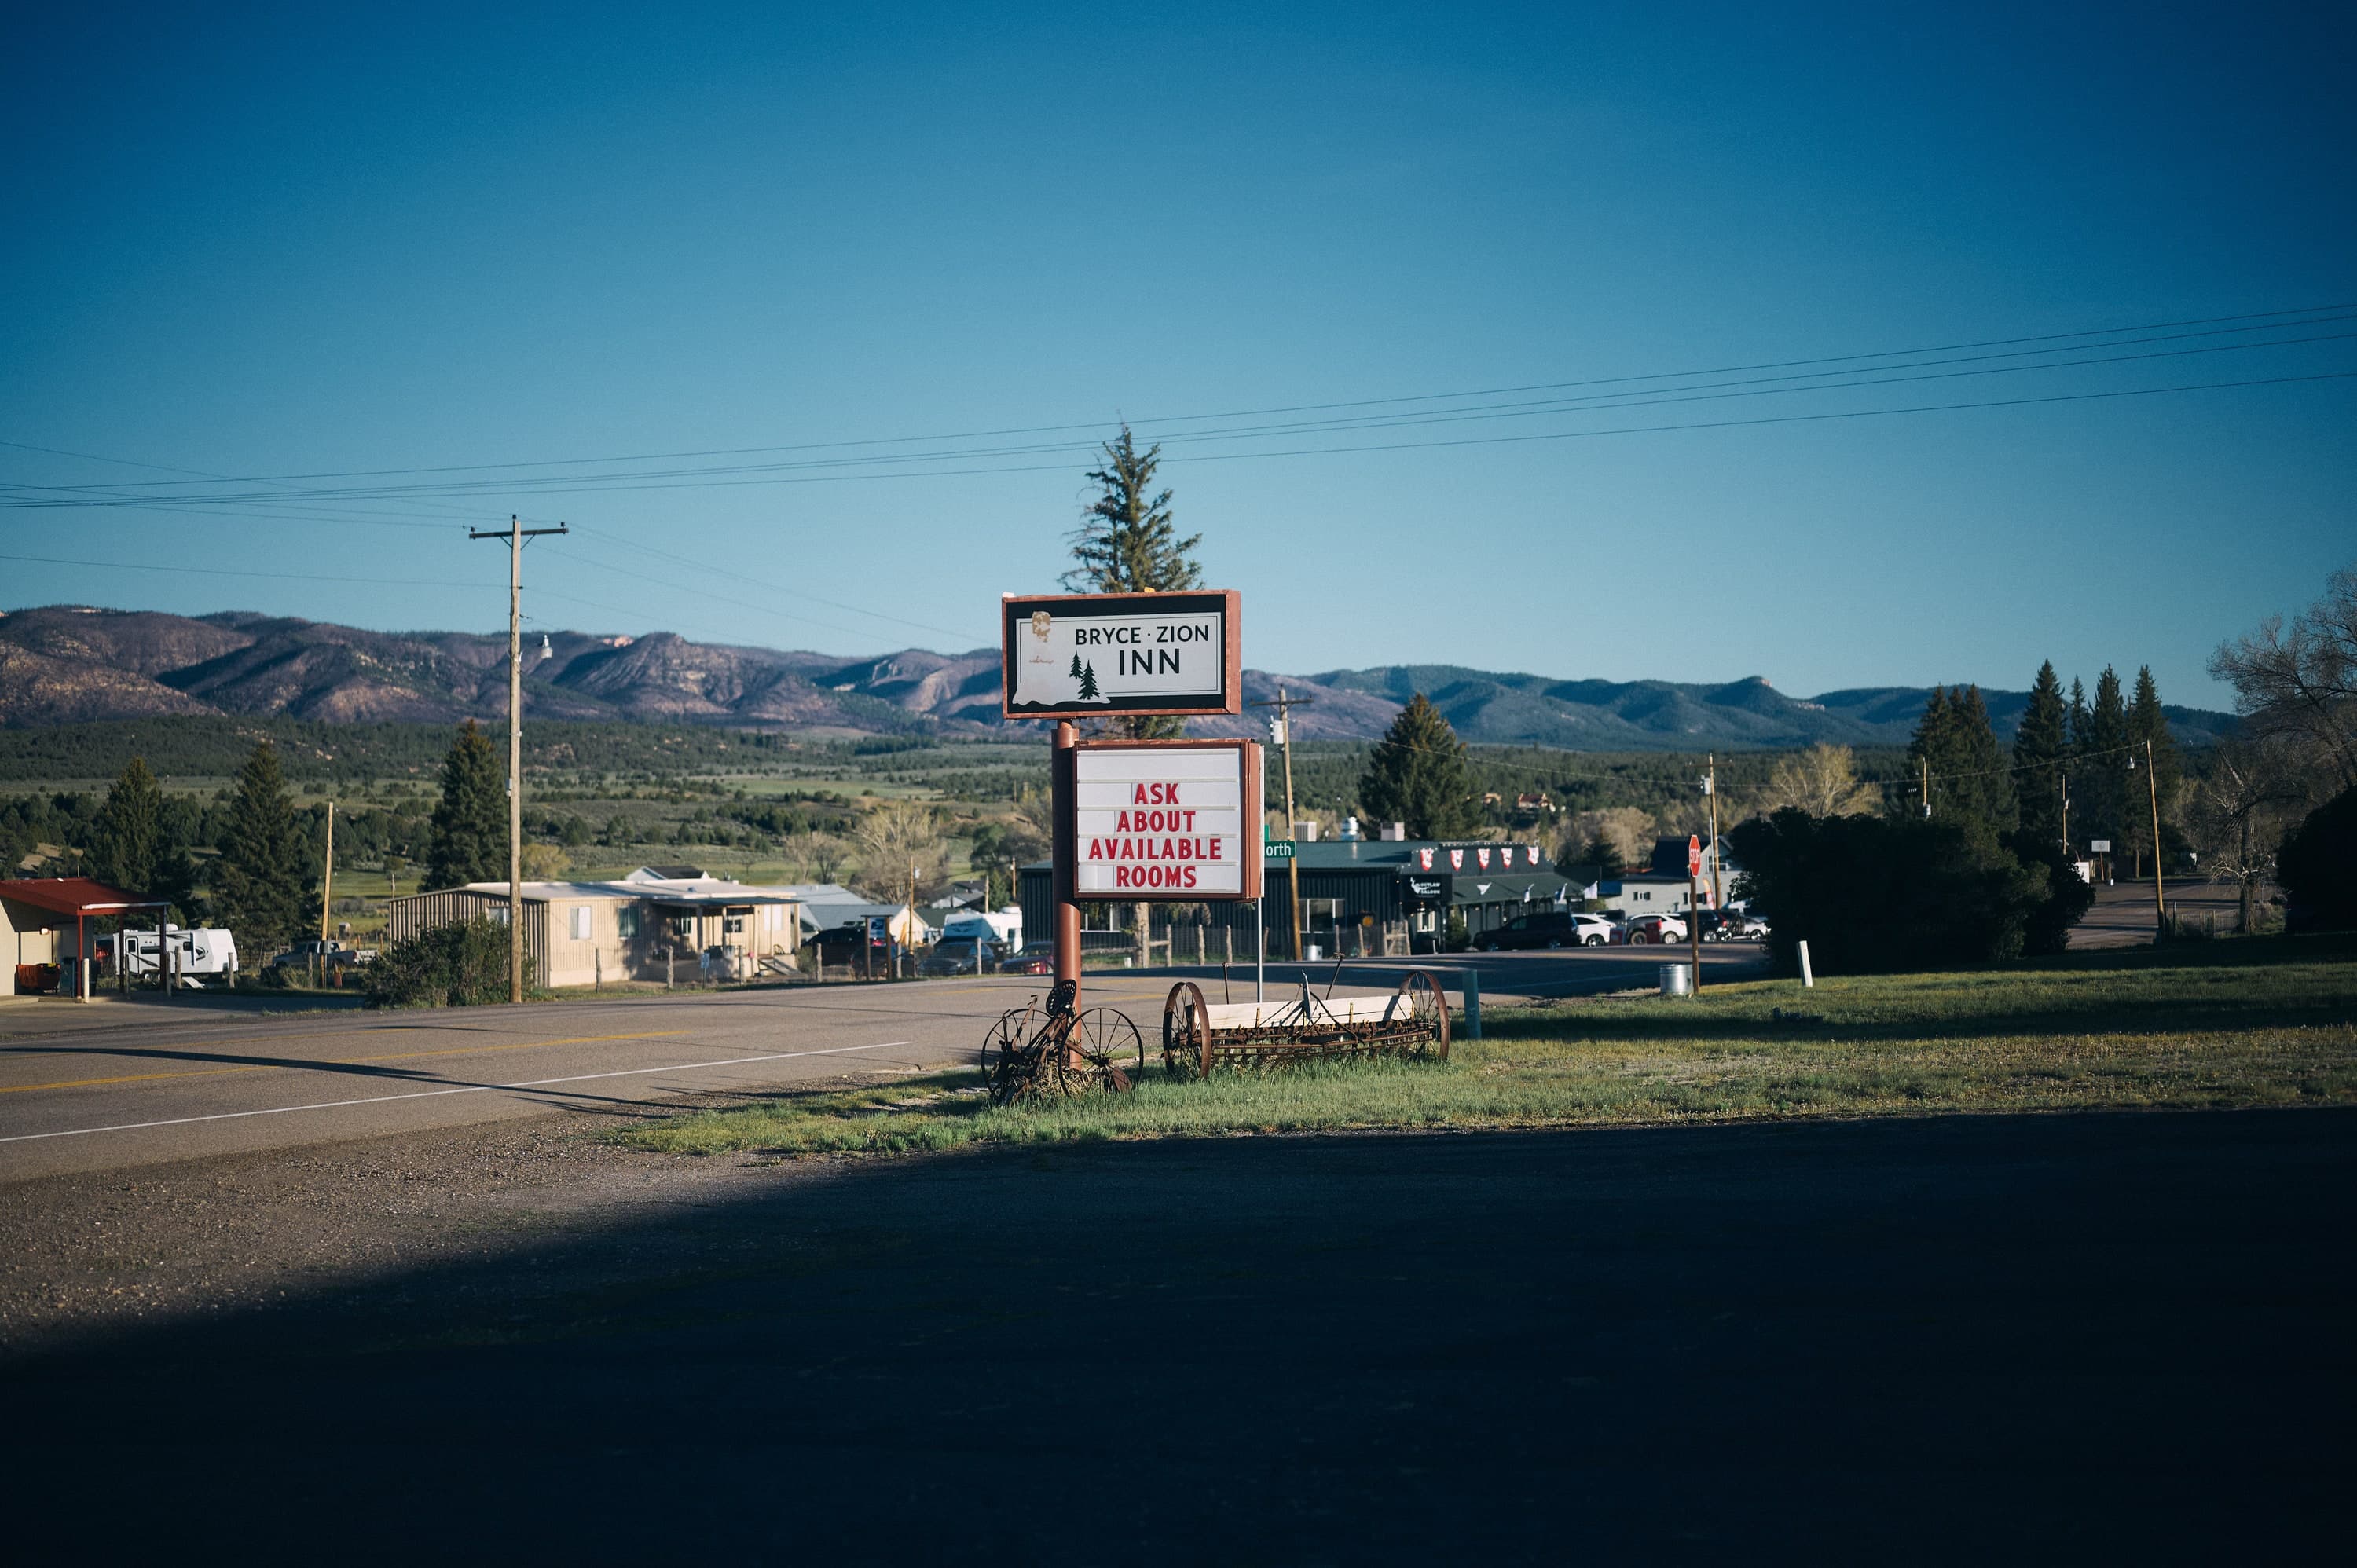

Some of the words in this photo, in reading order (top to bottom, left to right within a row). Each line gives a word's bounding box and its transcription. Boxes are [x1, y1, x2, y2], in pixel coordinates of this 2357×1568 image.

[1076, 627, 1141, 645] BRYCE
[1157, 625, 1208, 643] ZION
[1120, 648, 1180, 676] INN
[1134, 783, 1179, 805] ASK
[1116, 811, 1196, 833] ABOUT
[1088, 838, 1222, 860] AVAILABLE
[1266, 842, 1292, 856] orth
[1690, 848, 1699, 864] STOP
[1116, 866, 1197, 888] ROOMS
